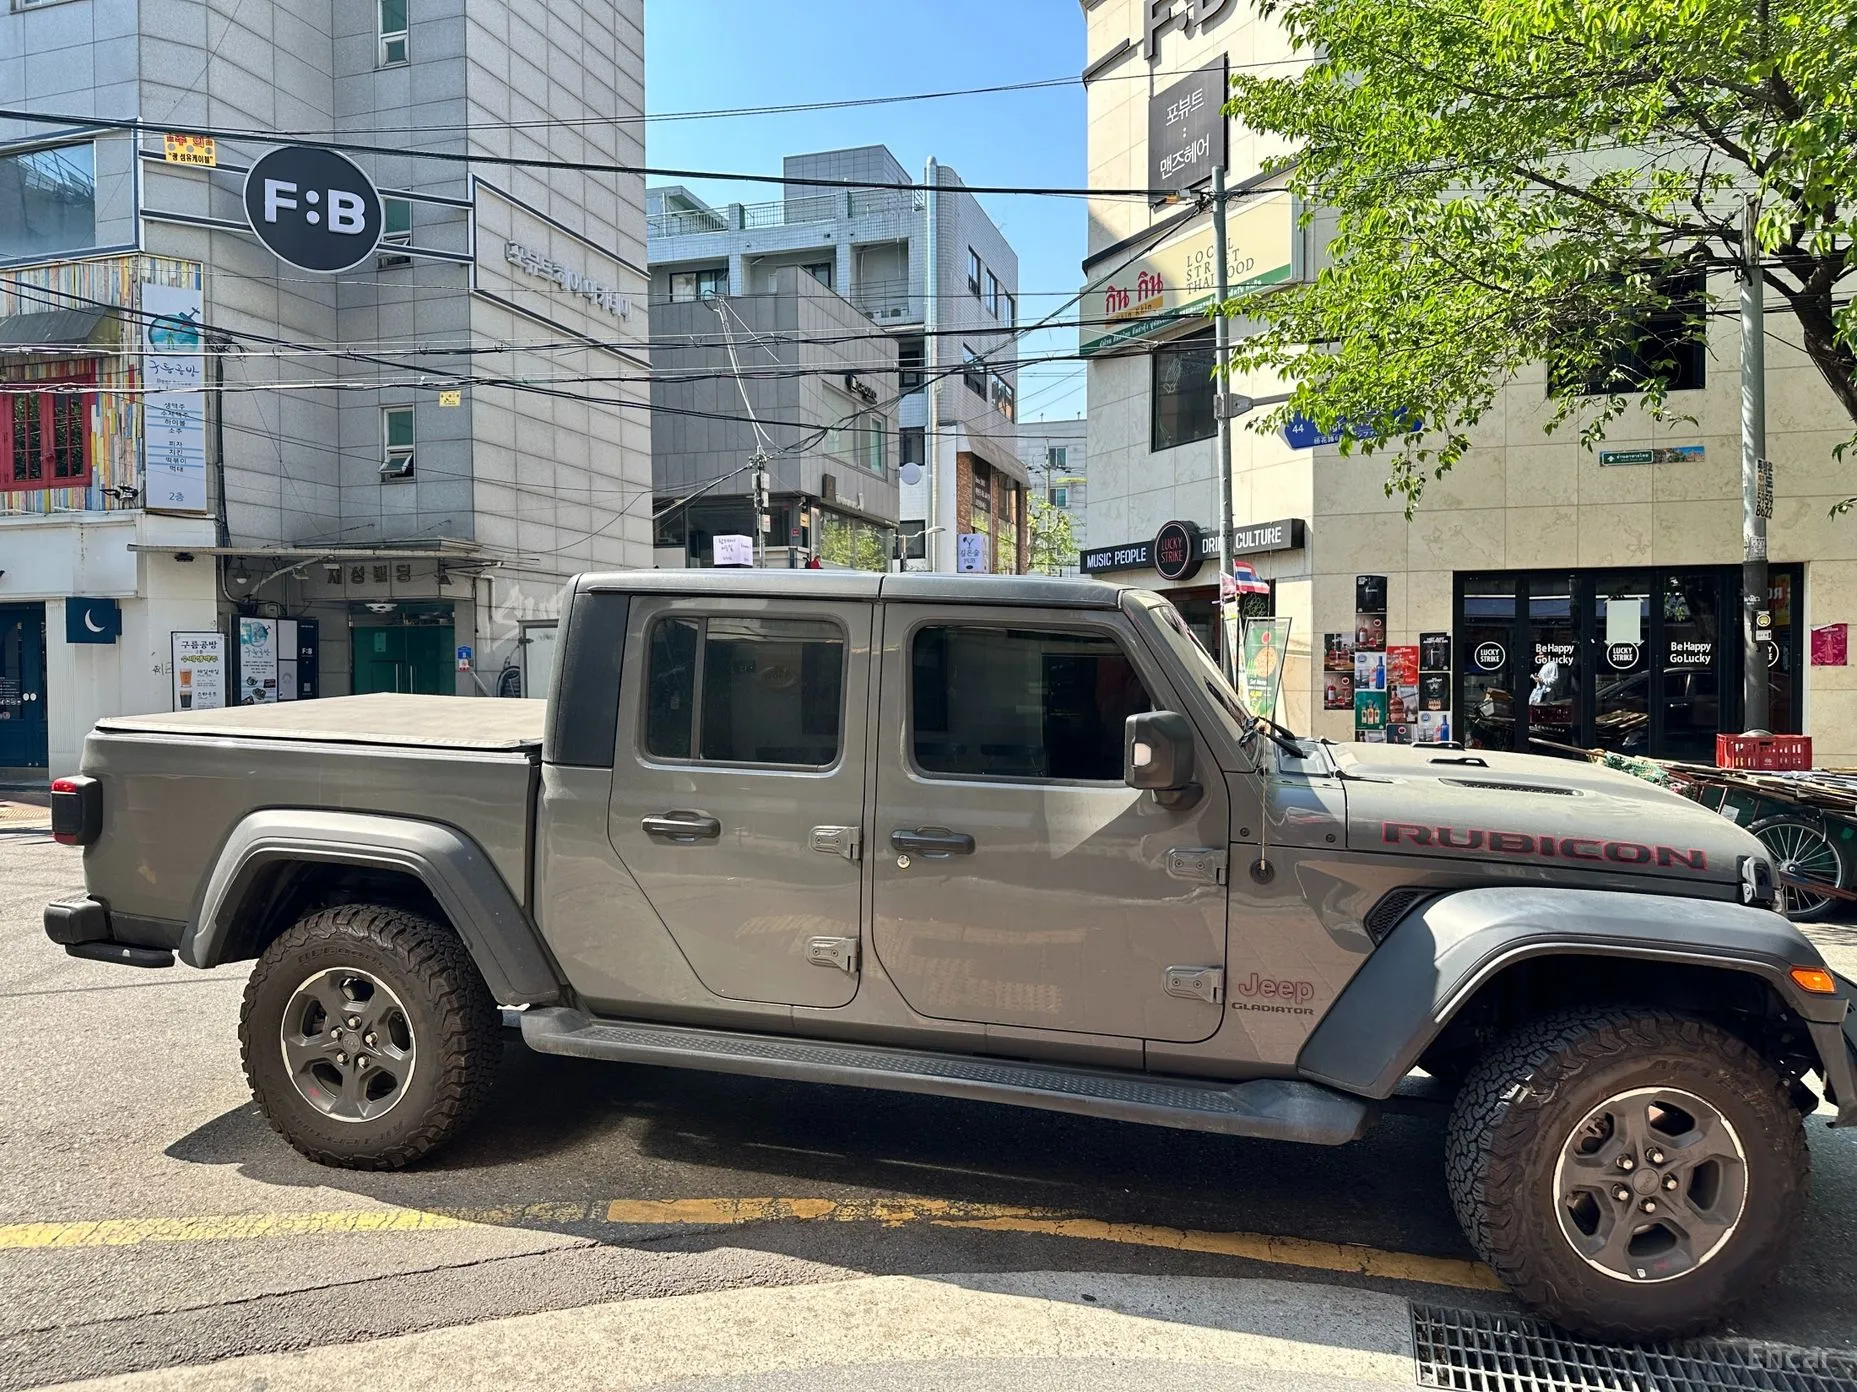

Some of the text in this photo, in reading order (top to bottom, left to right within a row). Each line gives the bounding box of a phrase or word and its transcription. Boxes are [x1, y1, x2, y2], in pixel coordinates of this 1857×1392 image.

[1166, 88, 1204, 126] 포뷰트
[1160, 132, 1209, 180] 맨즈헤어
[264, 178, 366, 236] F:B
[1187, 237, 1233, 268] LOCL
[1186, 248, 1239, 282] STRT
[1187, 273, 1214, 295] THAI
[1226, 257, 1254, 279] OOD
[1137, 271, 1164, 302] กิน
[1292, 424, 1305, 434] 44
[169, 441, 182, 449] 피자
[169, 449, 183, 457] 치킨
[169, 492, 184, 502] 2층
[1161, 536, 1183, 551] LUCKY
[1235, 526, 1282, 549] CULTURE
[1087, 547, 1146, 568] MUSIC PEOPLE
[1161, 550, 1183, 564] STRIKE
[181, 640, 218, 650] 구름공방
[1480, 648, 1500, 656] LUCKY
[1535, 644, 1574, 654] Be Happy
[1671, 642, 1712, 653] Be Happy
[1535, 656, 1547, 665] Go
[1612, 654, 1633, 662] STRIKE
[1670, 653, 1711, 665] Go Lucky
[1381, 821, 1708, 871] RUBICON
[1238, 972, 1315, 1005] Jeep
[1232, 1002, 1315, 1016] GLADIATOR
